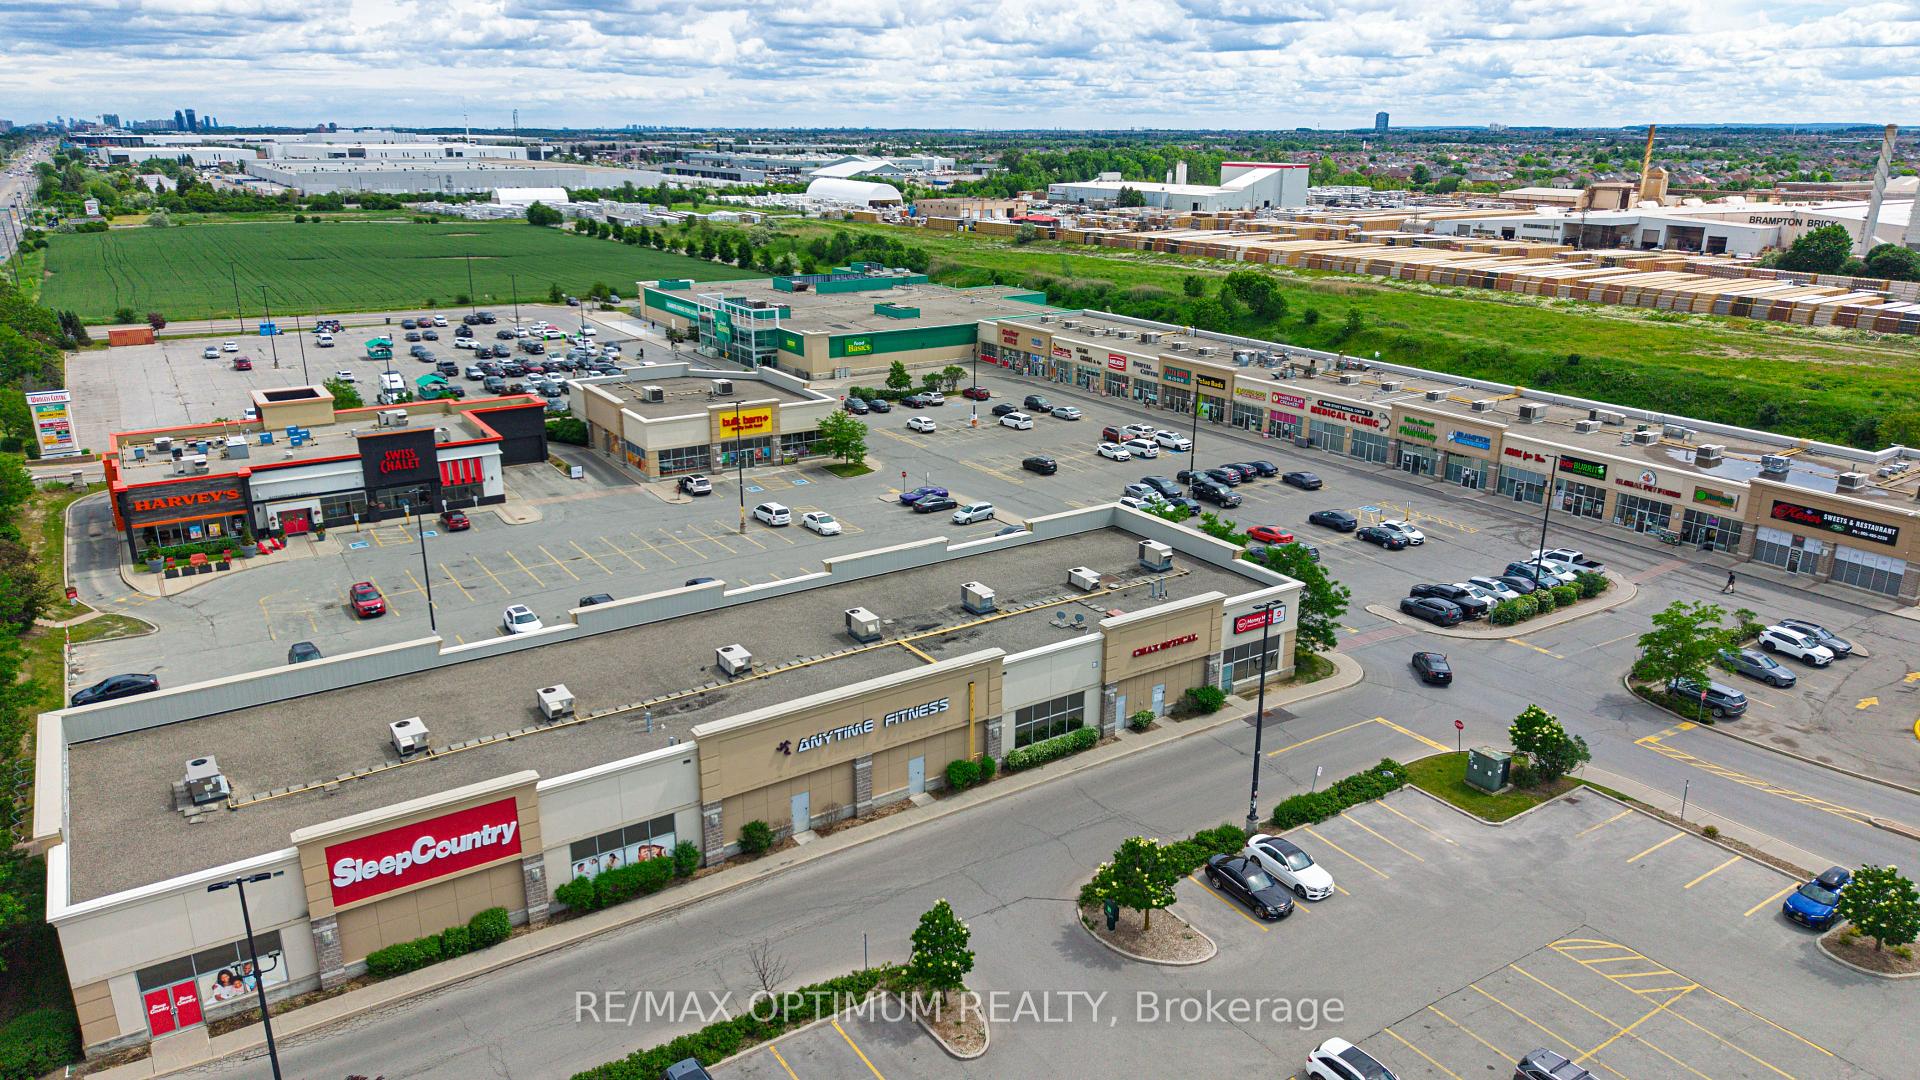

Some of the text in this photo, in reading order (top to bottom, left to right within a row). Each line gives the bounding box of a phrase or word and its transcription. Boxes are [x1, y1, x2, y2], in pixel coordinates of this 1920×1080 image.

[1749, 216, 1838, 228] BRAMPTON BRICK
[847, 344, 872, 354] Basics
[743, 415, 762, 425] barn
[1310, 405, 1380, 428] MEDICAL CLINIC
[385, 448, 416, 460] SWISS
[380, 457, 420, 474] CHALET
[134, 489, 240, 512] HARVEY'S
[1824, 514, 1847, 525] SWEETS
[1856, 521, 1896, 535] RESTAURANT
[1160, 633, 1198, 650] OPTICAL
[797, 697, 950, 752] ANYTIME FITNESS
[332, 820, 517, 888] SleepCountry
